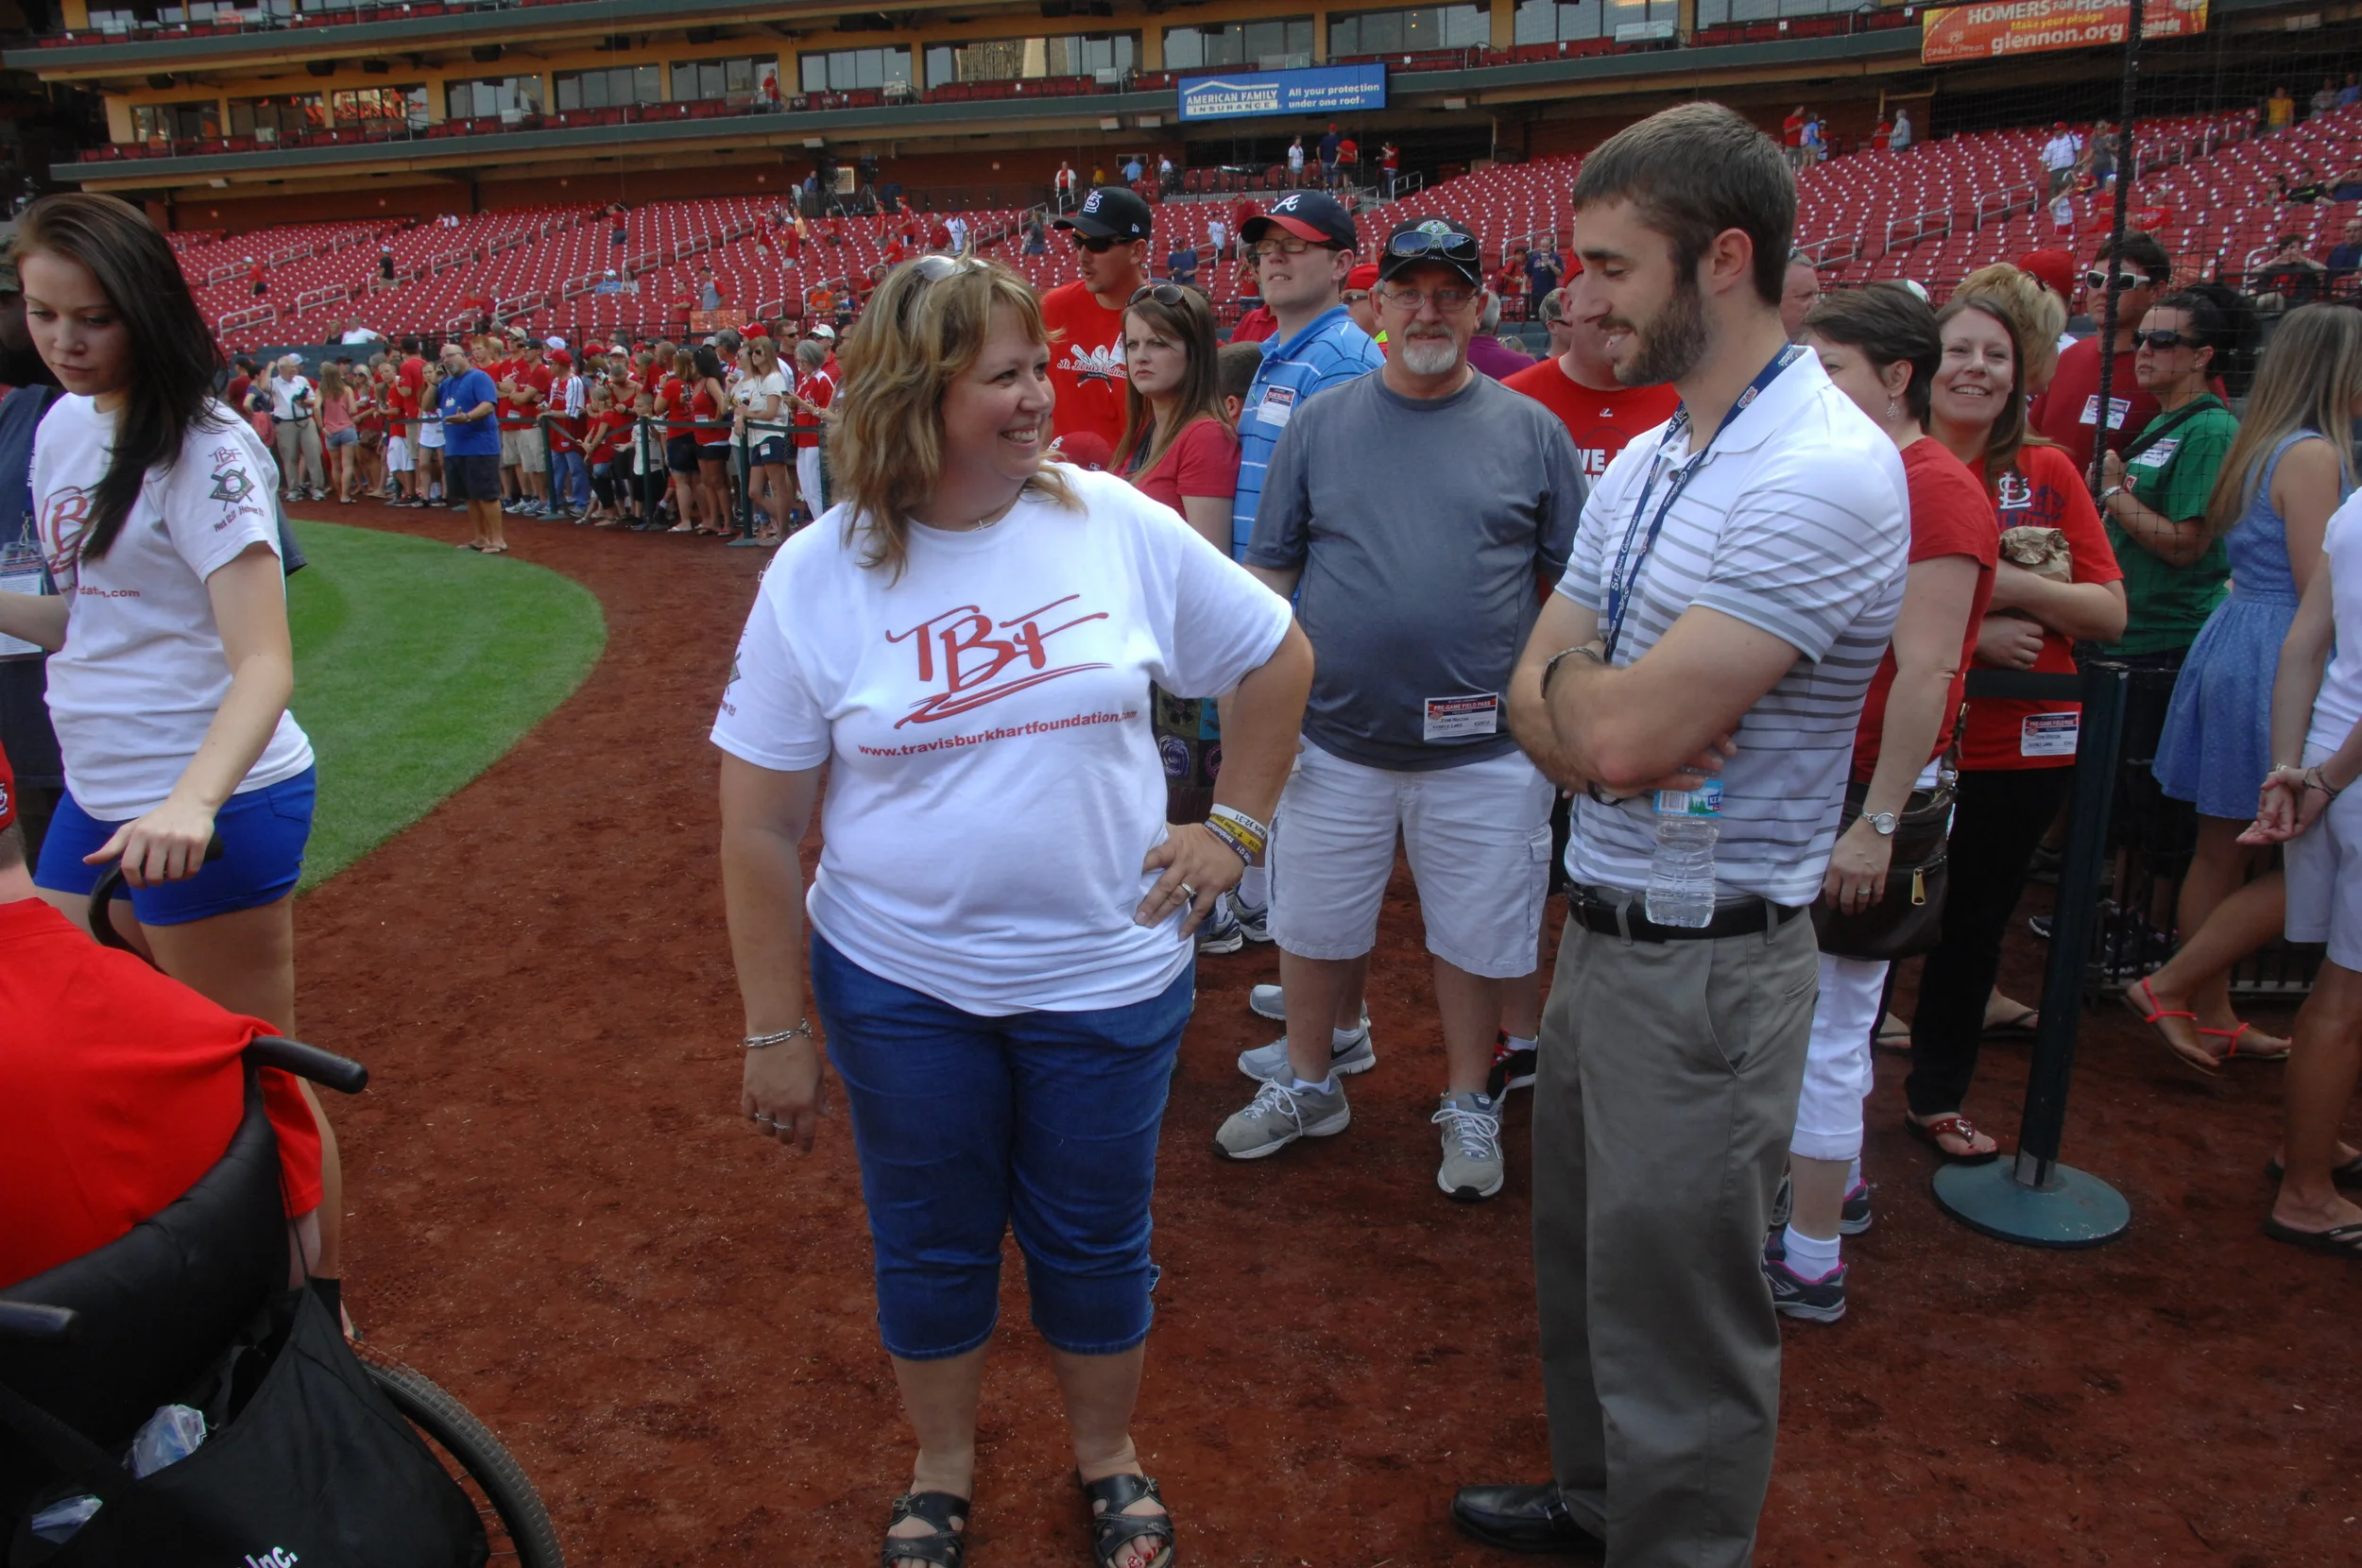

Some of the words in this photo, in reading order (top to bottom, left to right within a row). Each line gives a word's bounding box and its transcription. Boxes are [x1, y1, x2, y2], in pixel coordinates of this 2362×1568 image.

[1967, 0, 2051, 26] HOMERS
[2011, 19, 2039, 30] Make
[1991, 23, 2124, 56] glennon.org
[1187, 94, 1239, 106] AMERICAN
[1241, 90, 1278, 101] FAMILY
[1288, 88, 1302, 97] All
[1304, 87, 1326, 98] your
[1327, 83, 1379, 96] protection
[1193, 101, 1271, 113] INSURANCE
[1288, 98, 1317, 109] under
[1271, 194, 1302, 214] A
[1620, 515, 1639, 554] Cardinals
[858, 709, 1138, 757] www.travisburkhartfoundation.com
[244, 1545, 299, 1568] Inc.
